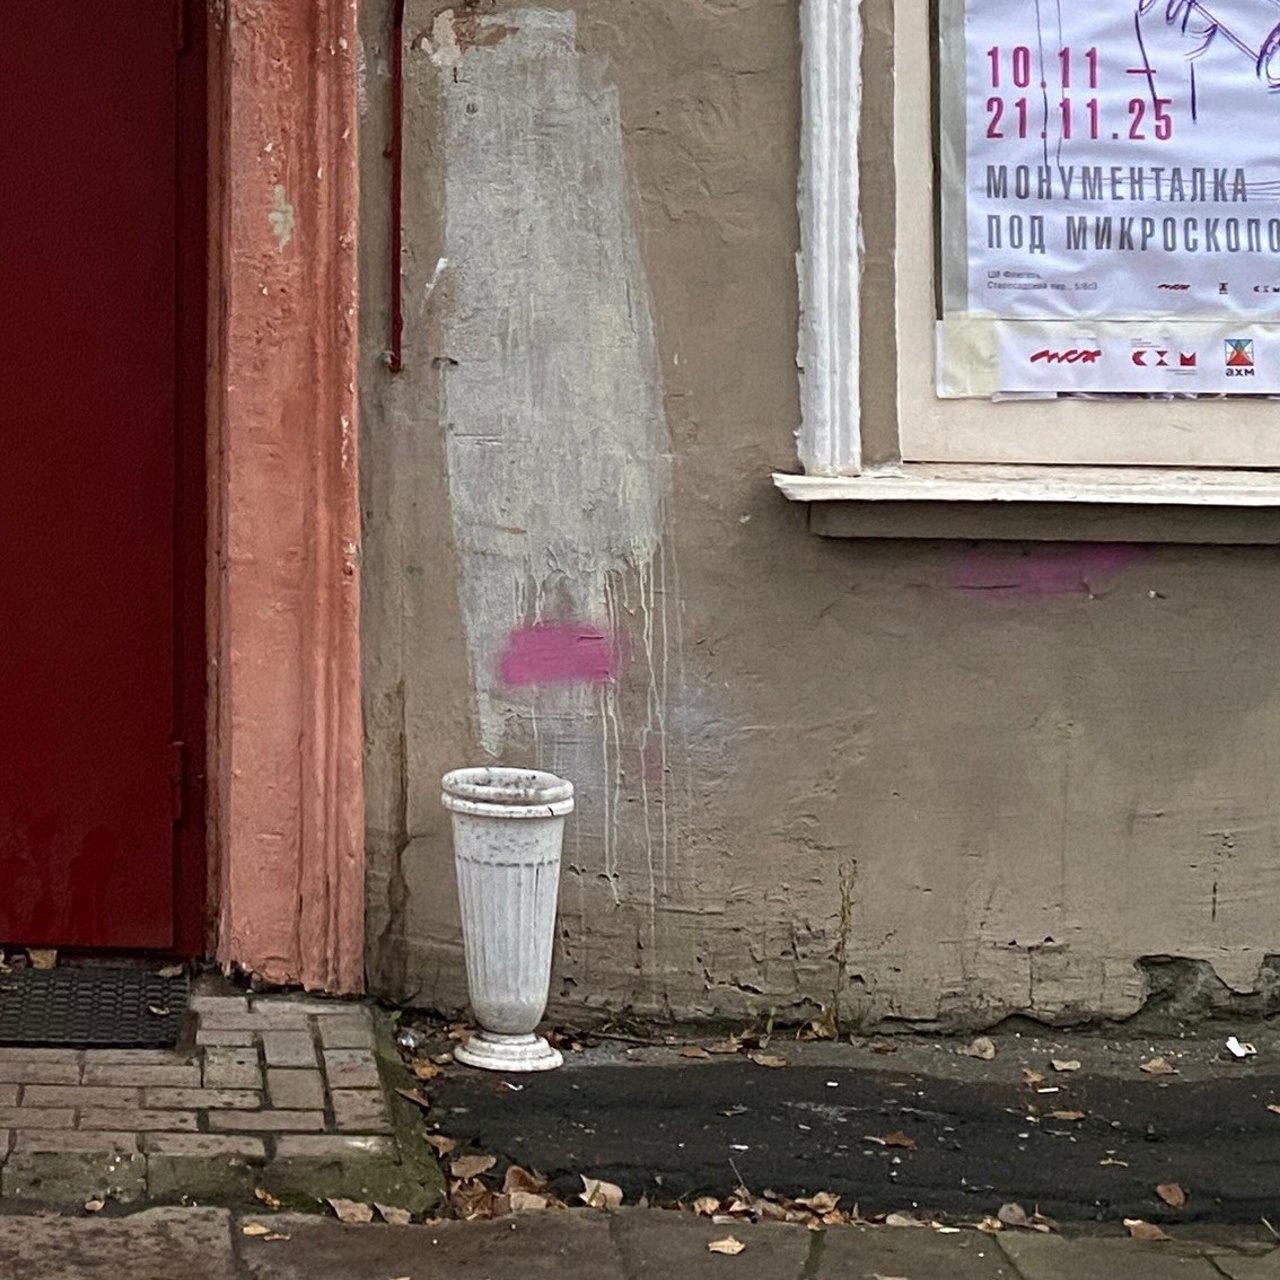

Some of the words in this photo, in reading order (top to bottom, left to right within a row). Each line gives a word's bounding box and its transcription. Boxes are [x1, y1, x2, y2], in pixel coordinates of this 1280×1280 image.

[986, 46, 1098, 89] 10.11
[986, 97, 1173, 141] 21.11.25
[986, 164, 1248, 203] МОНУМЕНТАЛКА
[987, 214, 1046, 255] ПОД
[1066, 215, 1280, 253] МИКРОСКОПО
